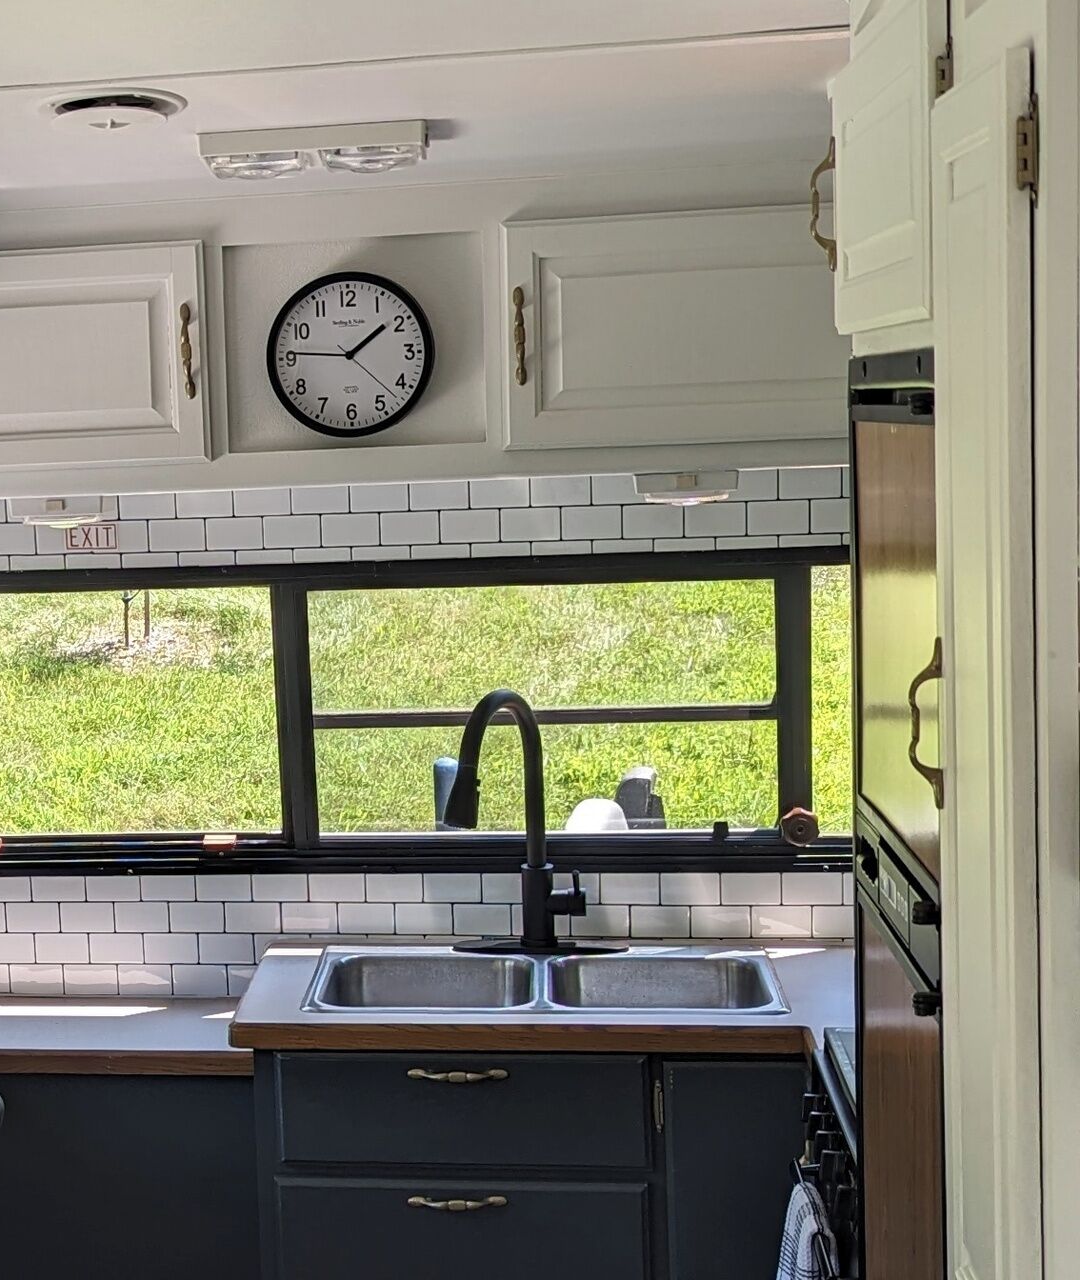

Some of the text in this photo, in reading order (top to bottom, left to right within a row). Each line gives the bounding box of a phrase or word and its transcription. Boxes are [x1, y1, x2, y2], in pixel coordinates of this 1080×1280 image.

[340, 290, 357, 308] 12
[315, 300, 326, 317] 11
[294, 322, 310, 341] 10
[393, 315, 405, 333] 2
[286, 350, 297, 367] 9
[403, 343, 416, 361] 3
[296, 378, 307, 395] 8
[395, 373, 407, 390] 4
[318, 397, 329, 414] 7
[346, 403, 358, 421] 6
[375, 395, 386, 412] 5
[69, 527, 112, 547] EXIT
